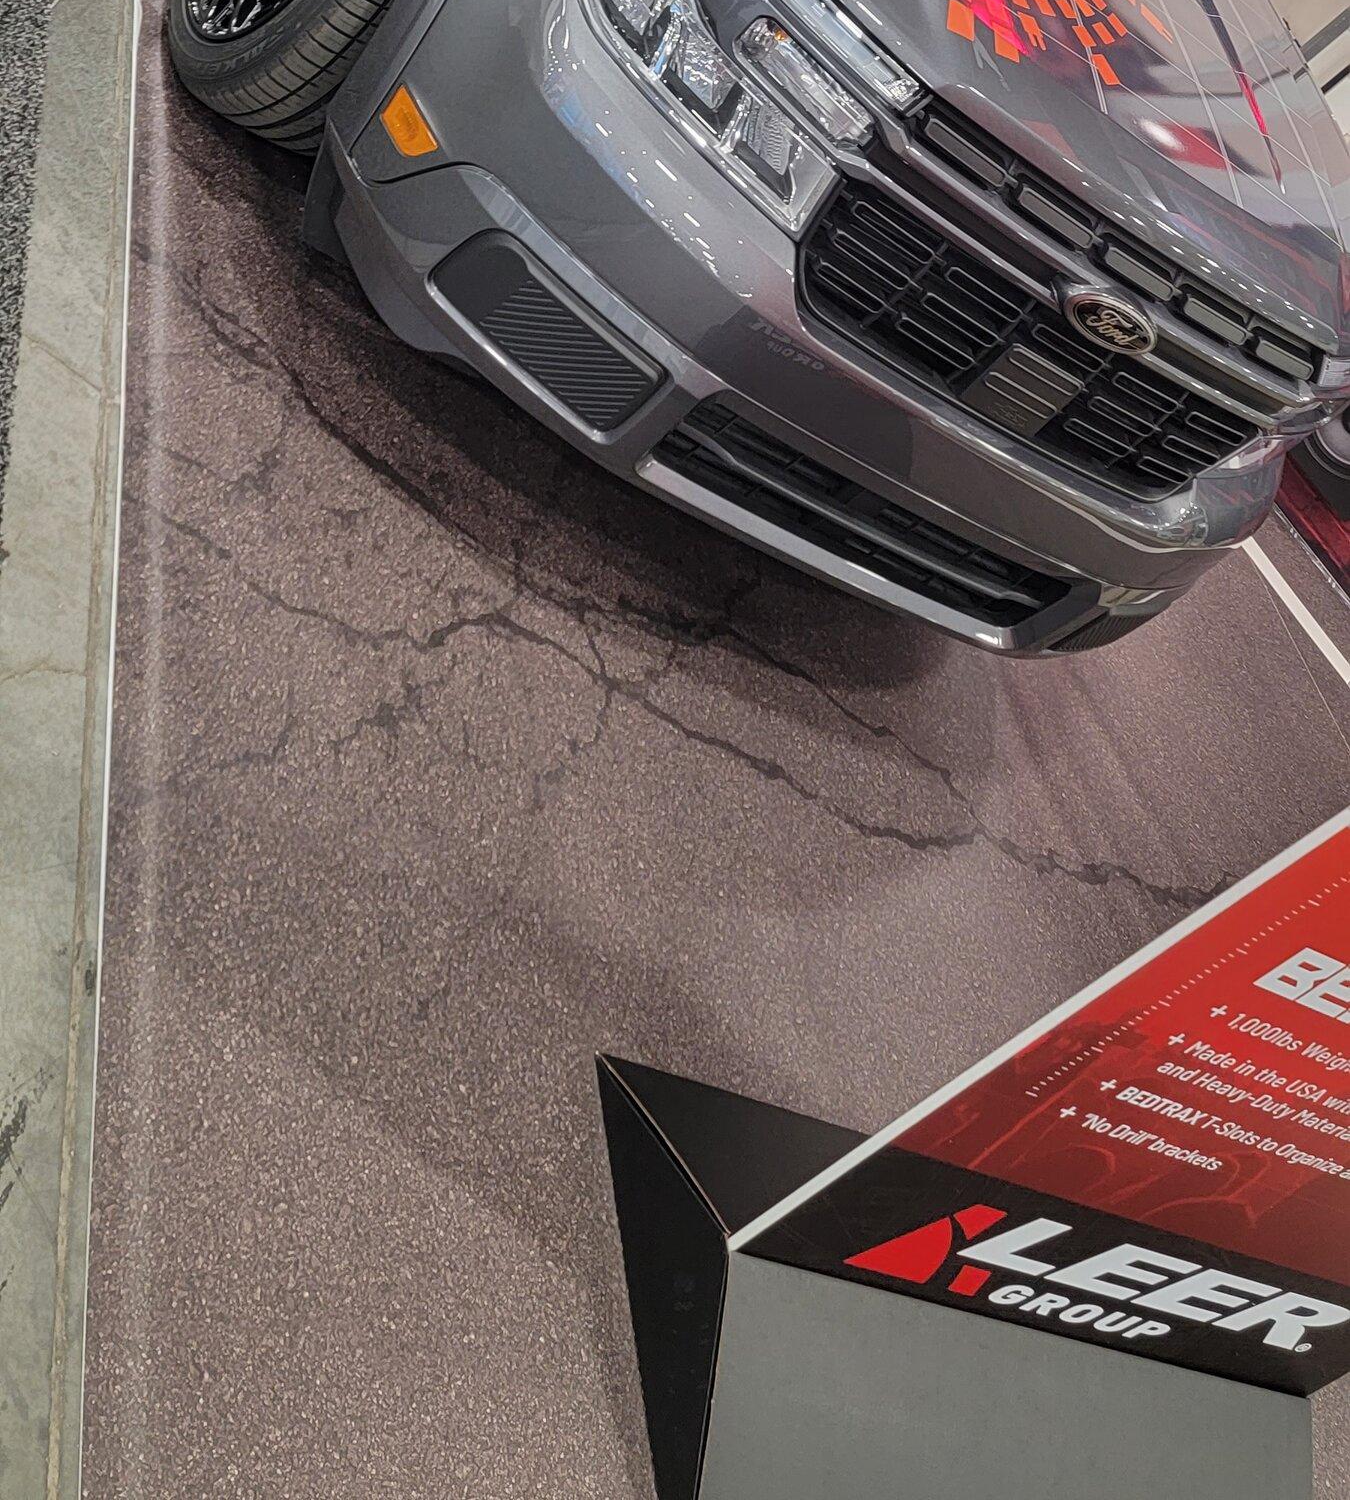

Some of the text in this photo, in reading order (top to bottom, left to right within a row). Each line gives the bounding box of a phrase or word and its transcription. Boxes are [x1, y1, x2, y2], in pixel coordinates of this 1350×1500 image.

[1085, 307, 1140, 349] Ford
[1227, 1013, 1303, 1051] 1,000lbs
[1156, 1062, 1202, 1083] and
[1192, 1069, 1296, 1120] Heavy-Duty
[1184, 1041, 1237, 1069] Made
[1233, 1059, 1256, 1077] in
[1253, 1068, 1288, 1088] the
[1285, 1079, 1327, 1103] USA
[1115, 1086, 1208, 1126] BEDTRAX
[1201, 1115, 1261, 1146] T-Slots
[1256, 1137, 1278, 1152] to
[1275, 1143, 1345, 1176] Organize
[1147, 1137, 1223, 1171] brackets
[957, 1217, 1350, 1352] LEER
[988, 1284, 1172, 1340] GROUP
